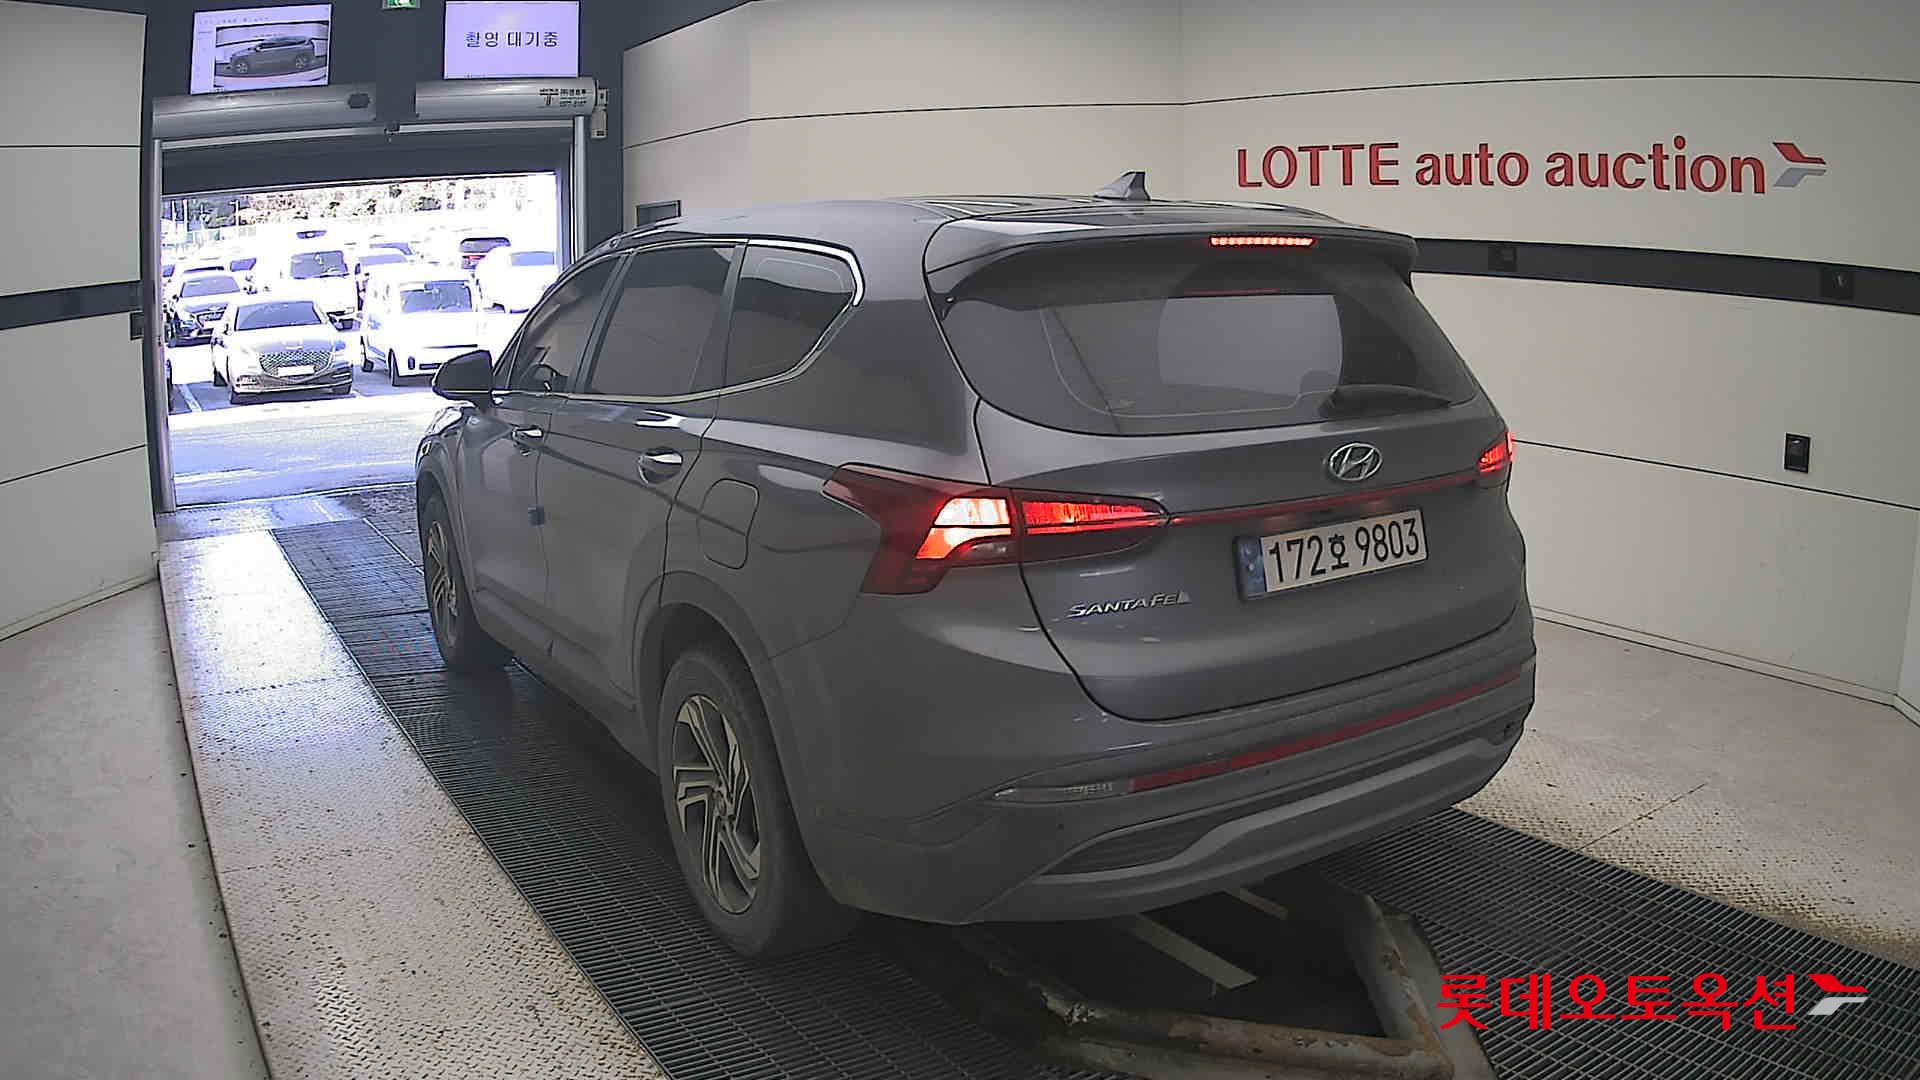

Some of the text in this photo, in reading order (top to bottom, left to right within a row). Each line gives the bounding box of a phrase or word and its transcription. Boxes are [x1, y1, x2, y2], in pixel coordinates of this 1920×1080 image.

[507, 31, 558, 48] 대기중
[1236, 135, 1766, 194] LOTTE auto auction
[1268, 517, 1420, 583] 172호 9803
